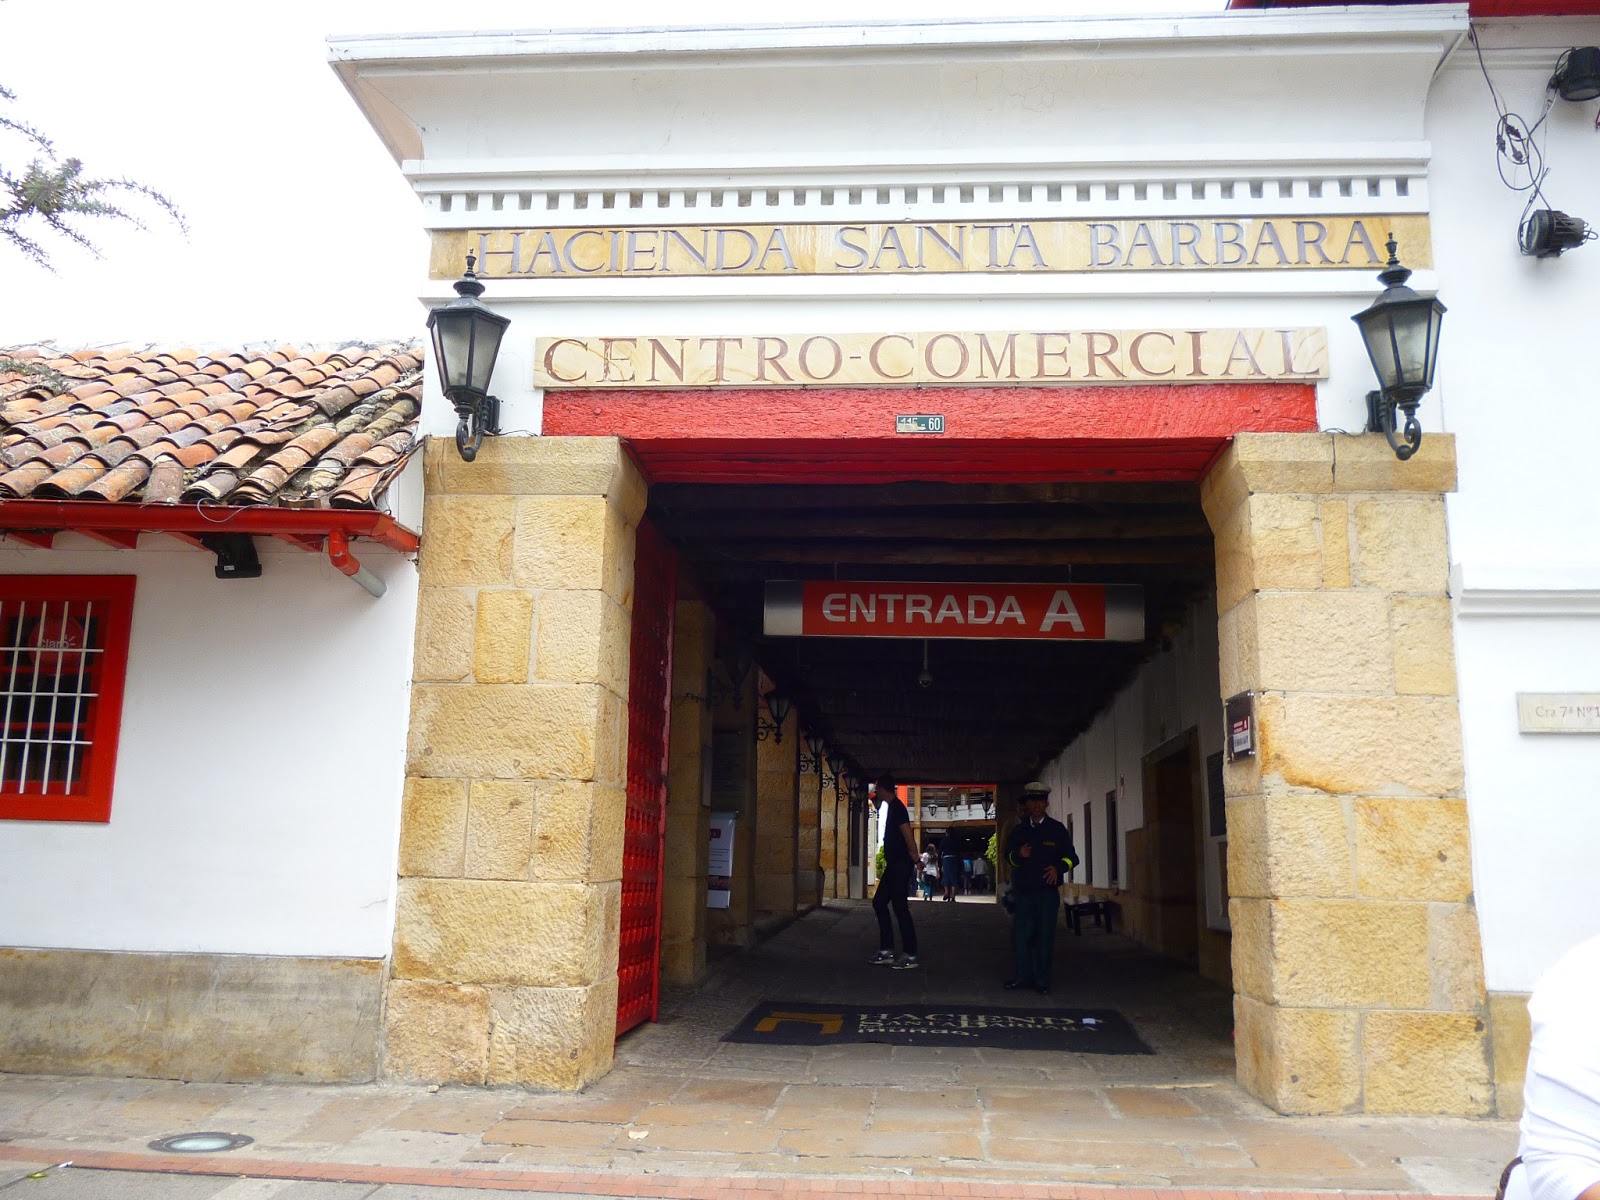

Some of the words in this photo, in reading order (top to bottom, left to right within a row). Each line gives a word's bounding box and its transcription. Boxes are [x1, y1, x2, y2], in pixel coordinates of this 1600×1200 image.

[476, 228, 799, 275] HACIENDA
[834, 223, 1049, 271] SANTA
[1087, 221, 1385, 267] BARBARA
[542, 330, 1321, 383] CENTRO-COMERCIAL
[928, 417, 941, 431] 60
[822, 592, 1027, 626] ENTRADA
[1038, 589, 1086, 633] A
[1535, 705, 1556, 718] Cra
